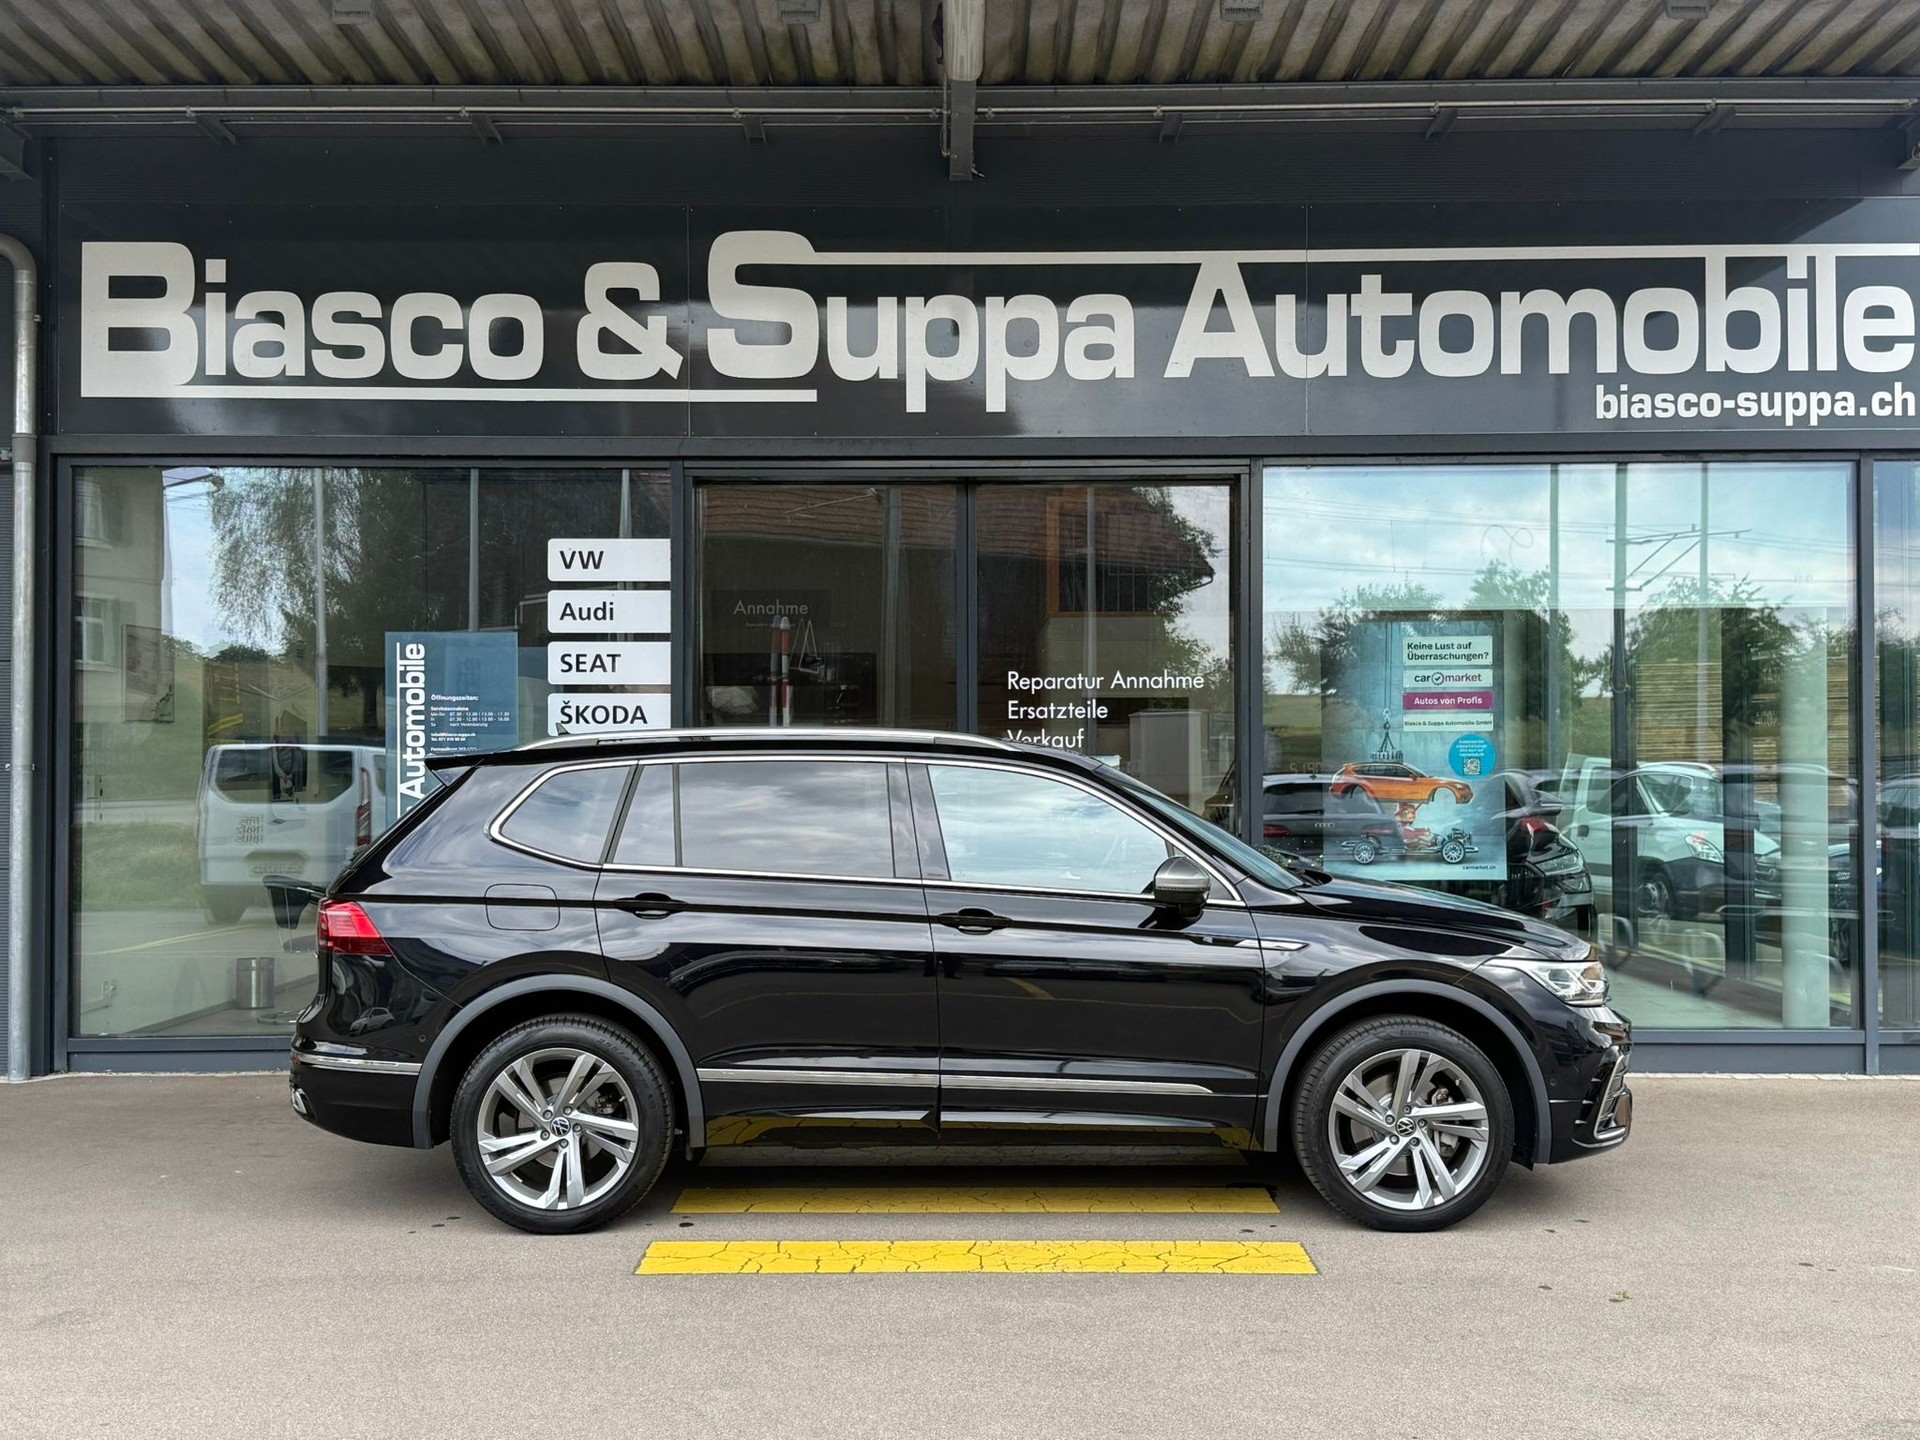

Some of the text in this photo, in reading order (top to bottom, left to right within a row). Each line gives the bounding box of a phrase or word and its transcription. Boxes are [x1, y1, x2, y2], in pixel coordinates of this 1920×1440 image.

[81, 230, 1916, 412] Biasco & Suppa Automobile
[1596, 382, 1917, 427] biasco-suppa.ch
[559, 550, 604, 570] VW
[559, 601, 614, 621] Audi
[733, 599, 809, 615] Annahme
[1407, 641, 1472, 651] Keine Lust auf
[560, 653, 621, 673] SEAT
[1407, 651, 1489, 662] Überraschungen?
[1007, 669, 1205, 694] Reparatur Annahme
[1008, 699, 1109, 719] Ersatzteile
[1413, 696, 1483, 705] Autos von Profis
[397, 643, 426, 800] Automobile
[560, 700, 648, 725] ŠKODA
